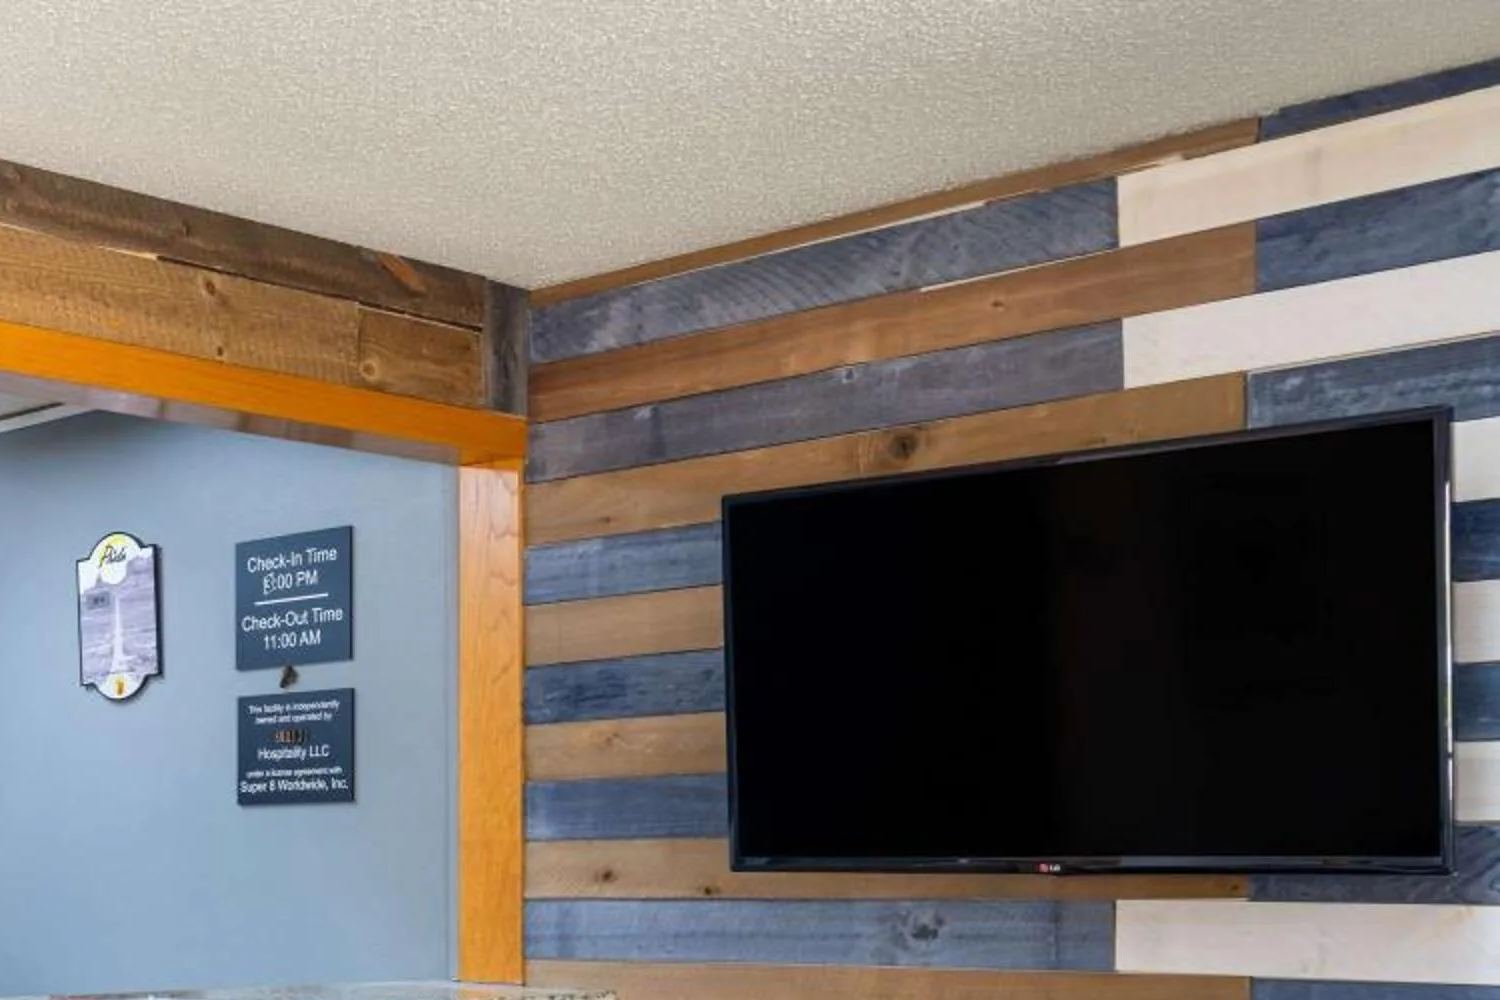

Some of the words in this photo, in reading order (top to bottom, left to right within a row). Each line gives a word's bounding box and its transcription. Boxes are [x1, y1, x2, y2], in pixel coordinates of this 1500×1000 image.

[247, 551, 303, 573] Check-In
[306, 547, 338, 564] Time
[295, 569, 318, 587] PM
[241, 609, 308, 633] Check-Out
[312, 606, 343, 623] Time
[264, 631, 297, 650] 11:00
[299, 627, 321, 646] AM
[258, 746, 306, 761] Hospitality
[309, 743, 329, 757] LLC
